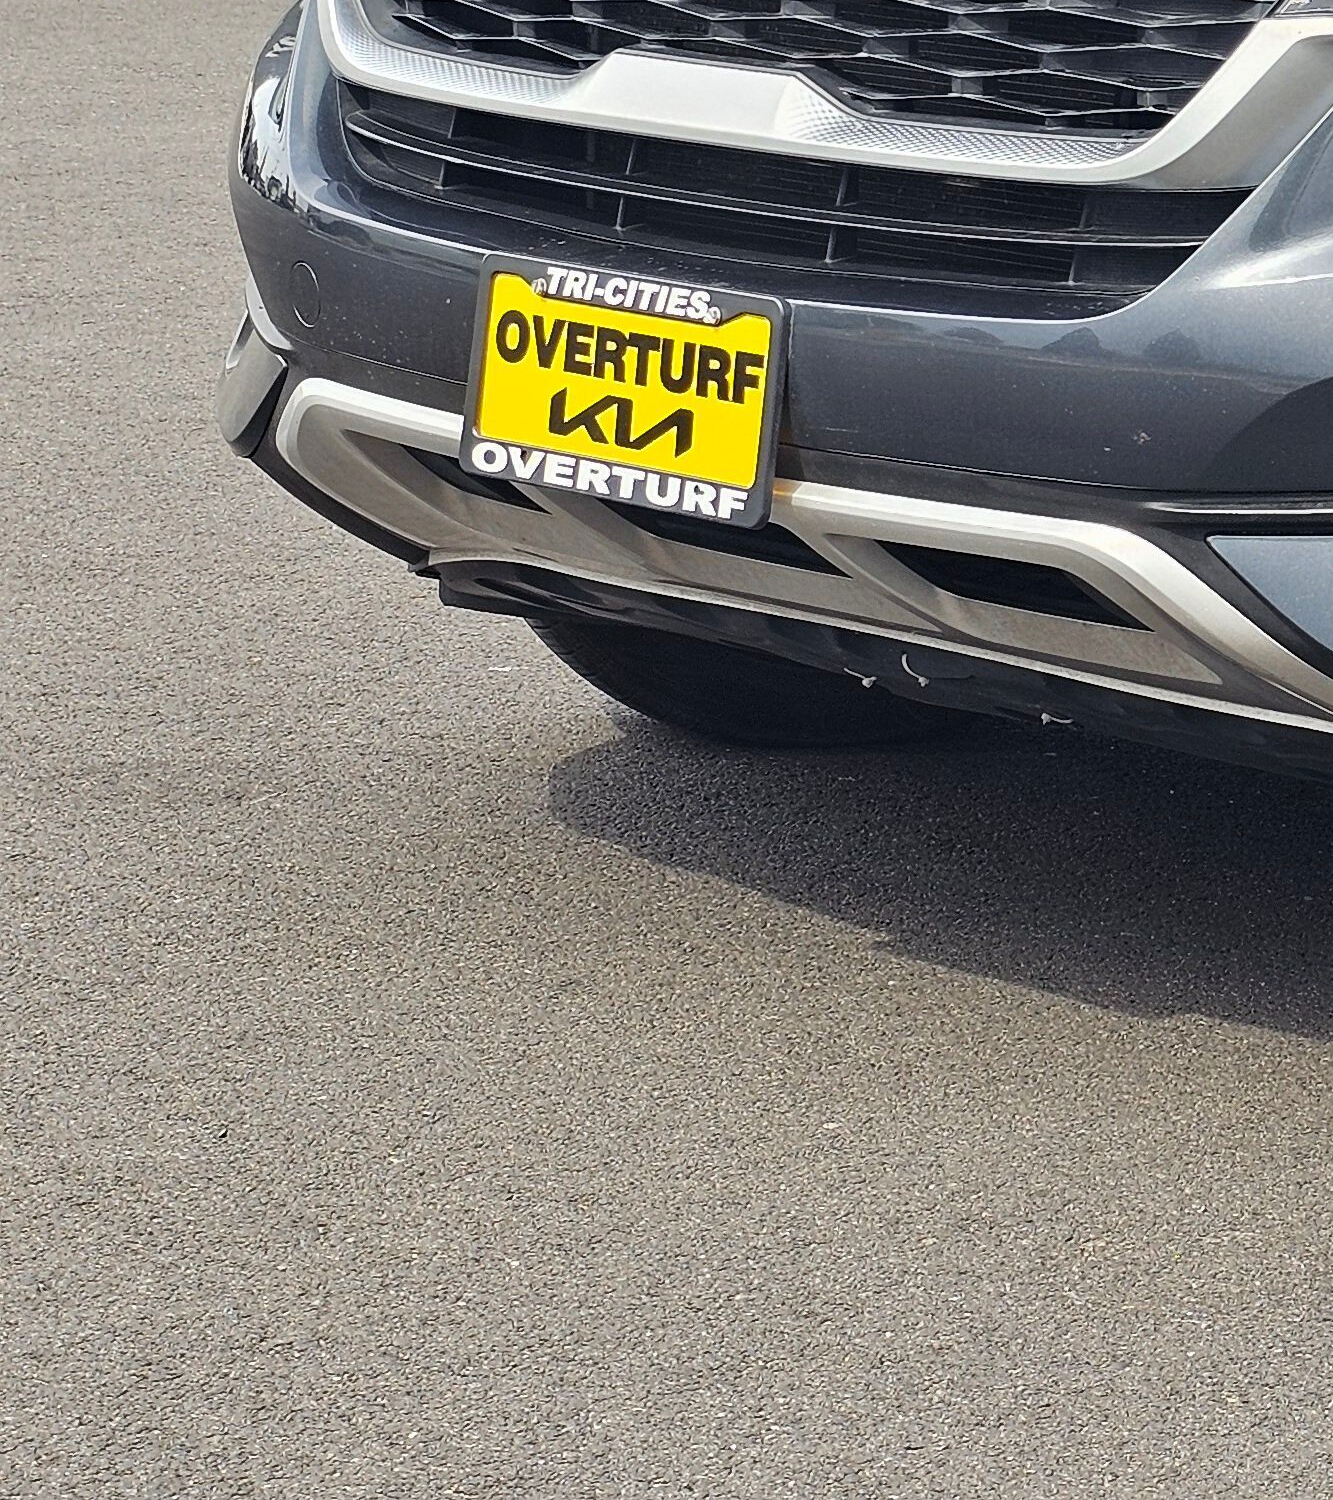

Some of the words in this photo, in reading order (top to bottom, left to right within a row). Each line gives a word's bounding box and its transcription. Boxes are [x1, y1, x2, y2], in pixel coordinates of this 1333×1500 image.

[546, 266, 712, 322] TRI-CITIES
[496, 309, 765, 405] OVERTURF
[471, 442, 749, 519] OVERTURF
